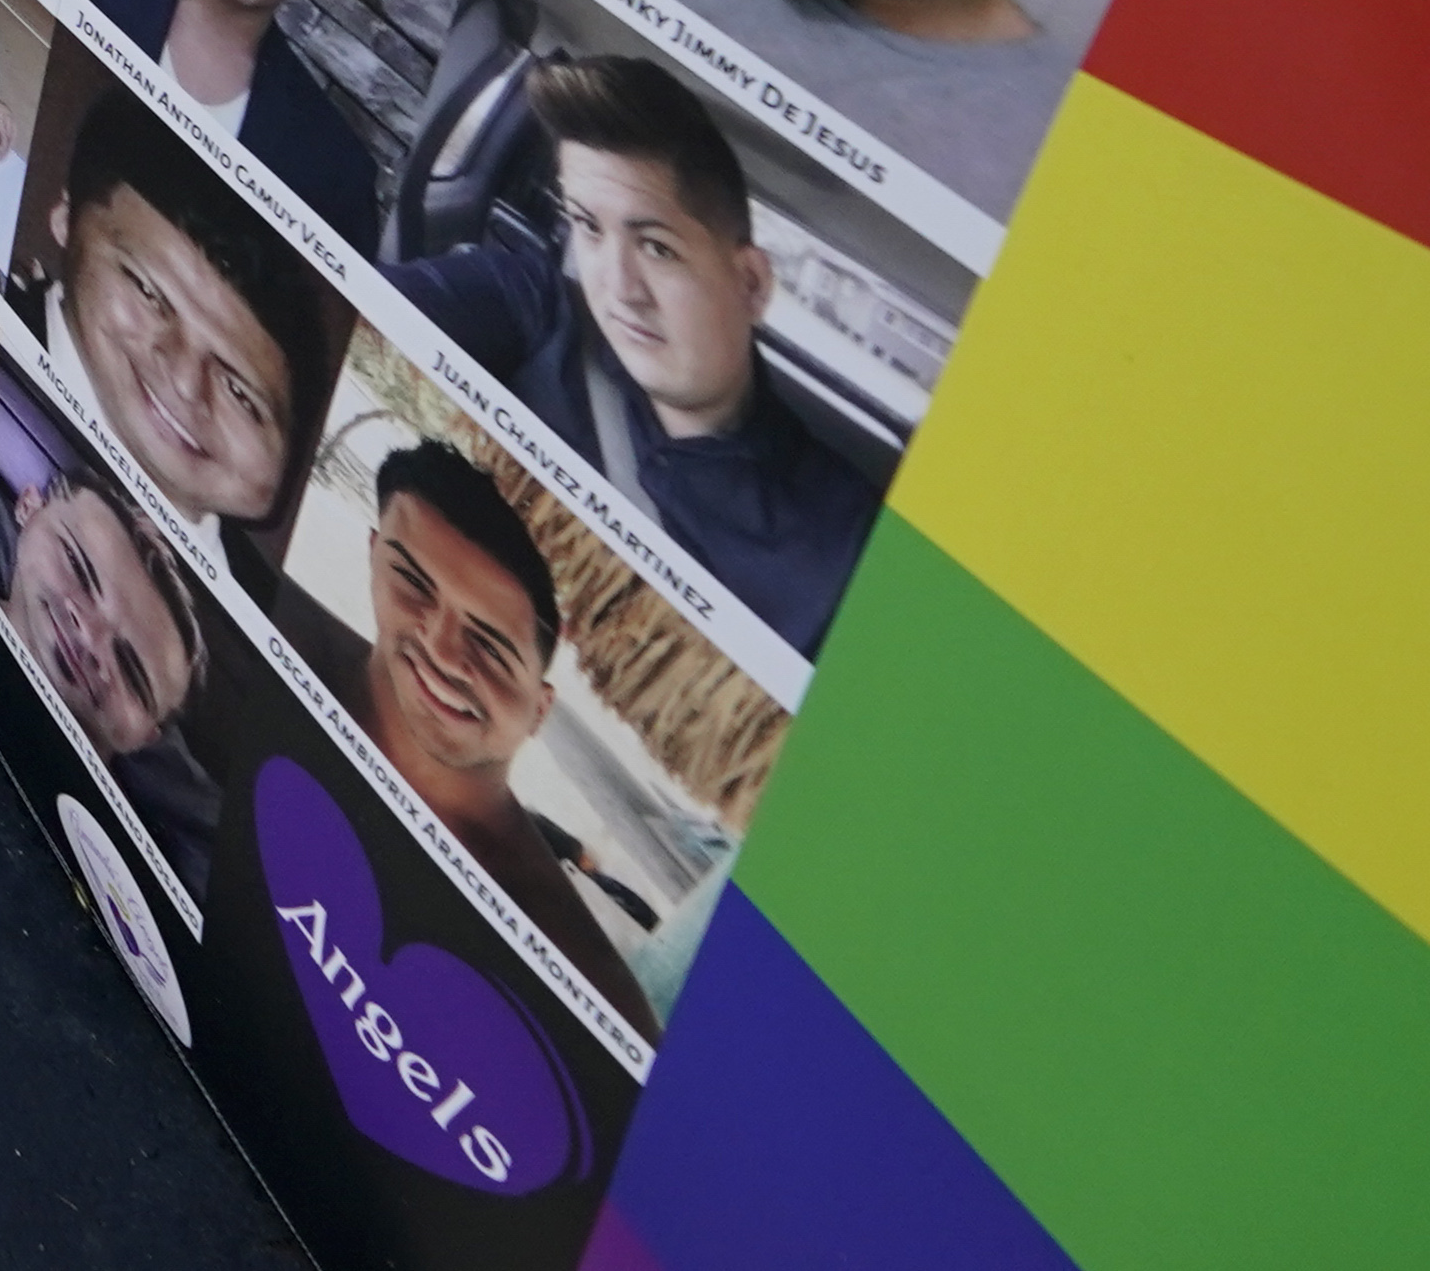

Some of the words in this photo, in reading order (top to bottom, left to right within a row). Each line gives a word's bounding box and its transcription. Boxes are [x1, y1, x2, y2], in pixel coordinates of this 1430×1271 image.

[77, 10, 156, 102] JONATHAN
[156, 90, 232, 169] ANTONIO
[235, 163, 298, 229] CAMUY
[299, 217, 347, 281] VEGA
[671, 15, 759, 88] JIMMY
[37, 352, 88, 425] MIGUEL
[88, 418, 133, 481] ANGEL
[134, 473, 217, 582] HONORATO
[431, 350, 491, 414] JUAN
[493, 406, 582, 501] CHAVEZ
[584, 494, 717, 621] MARTINEZ
[268, 637, 325, 712] OSCAR
[327, 709, 419, 821] AMBIORIX
[422, 821, 519, 936] ARACENA
[523, 932, 644, 1064] MONTERO
[275, 895, 514, 1186] Angels
